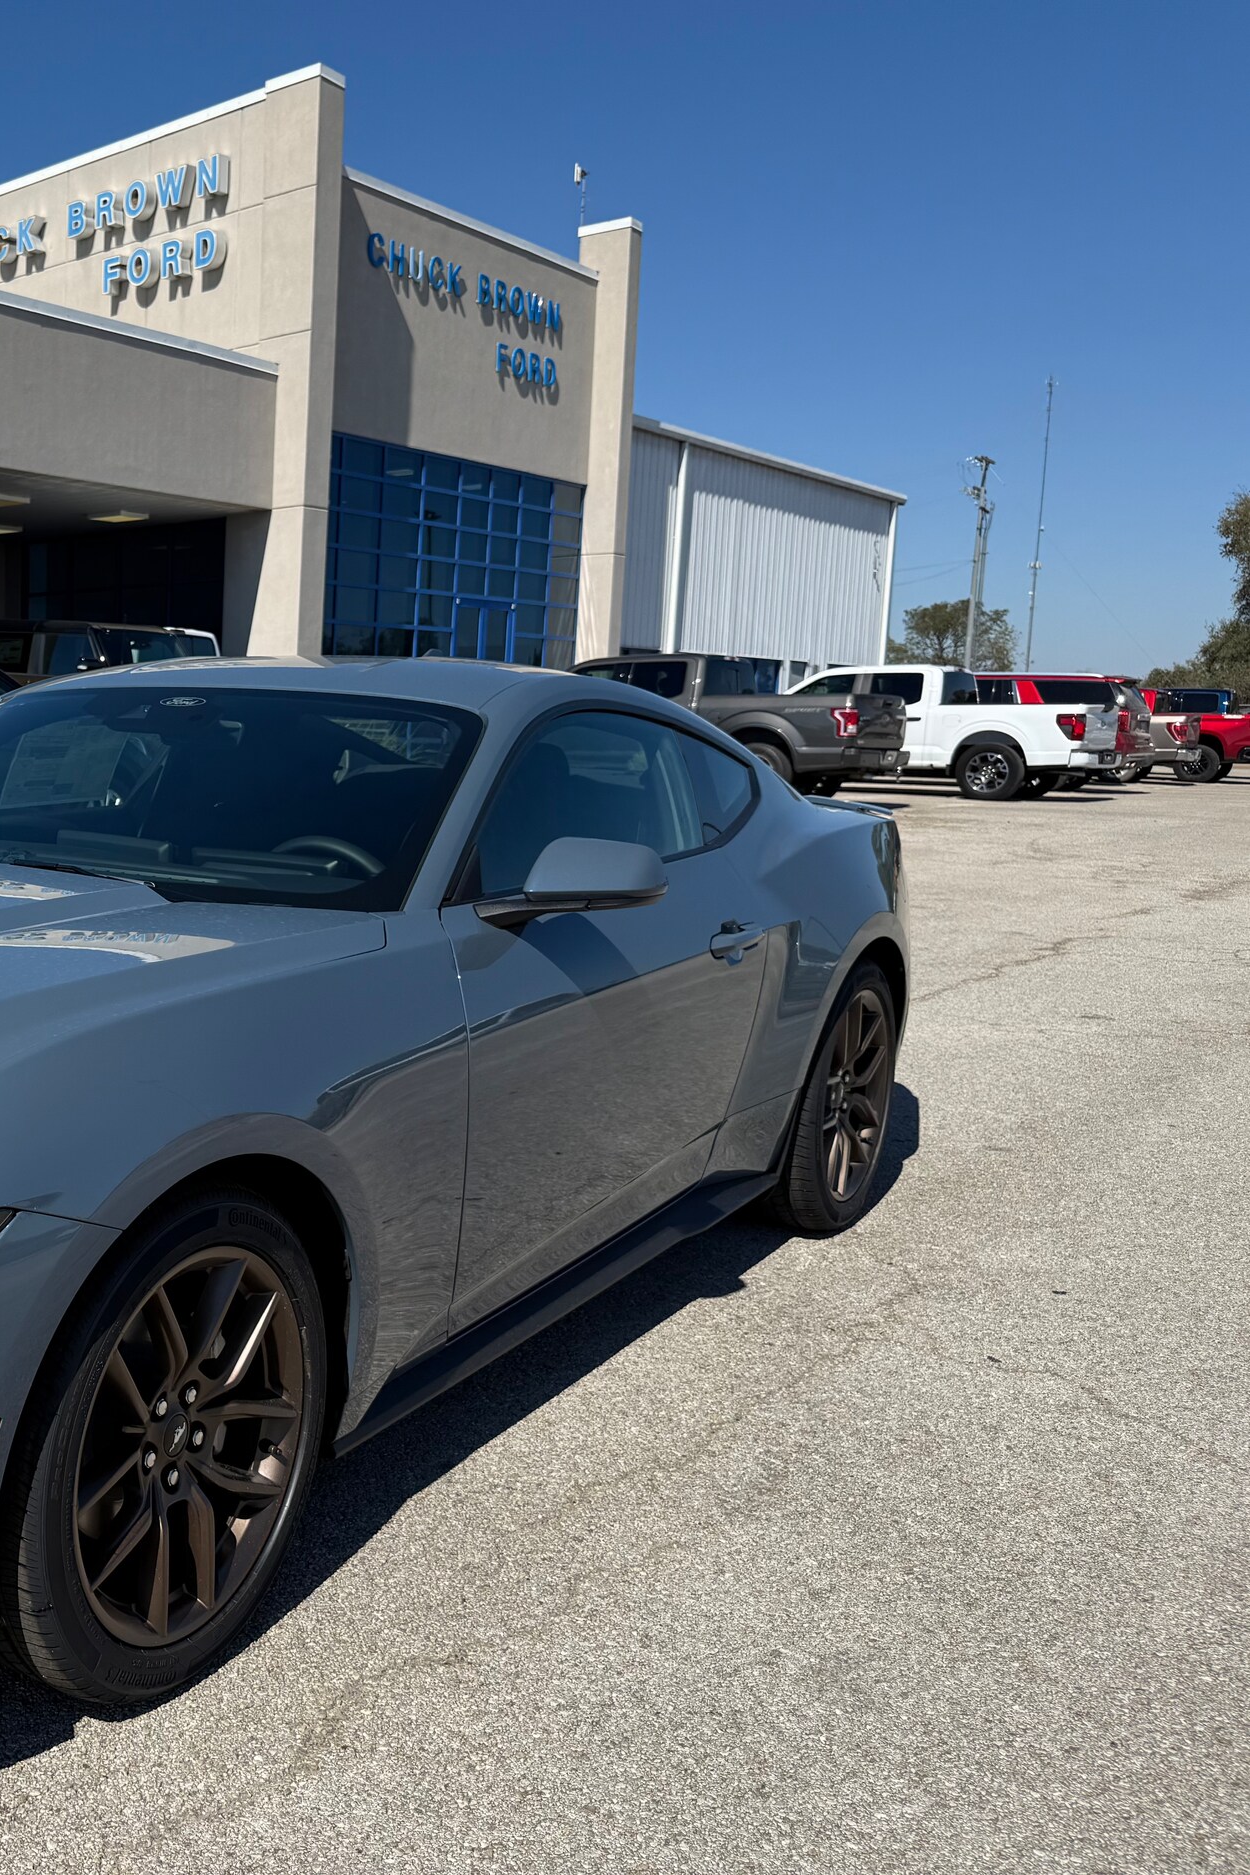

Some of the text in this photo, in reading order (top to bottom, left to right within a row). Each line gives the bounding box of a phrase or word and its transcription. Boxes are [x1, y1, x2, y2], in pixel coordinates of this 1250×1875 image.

[67, 154, 227, 239] BROWN
[102, 229, 221, 296] FORD
[367, 232, 560, 332] CHUCK BROWN
[495, 342, 557, 387] FORD
